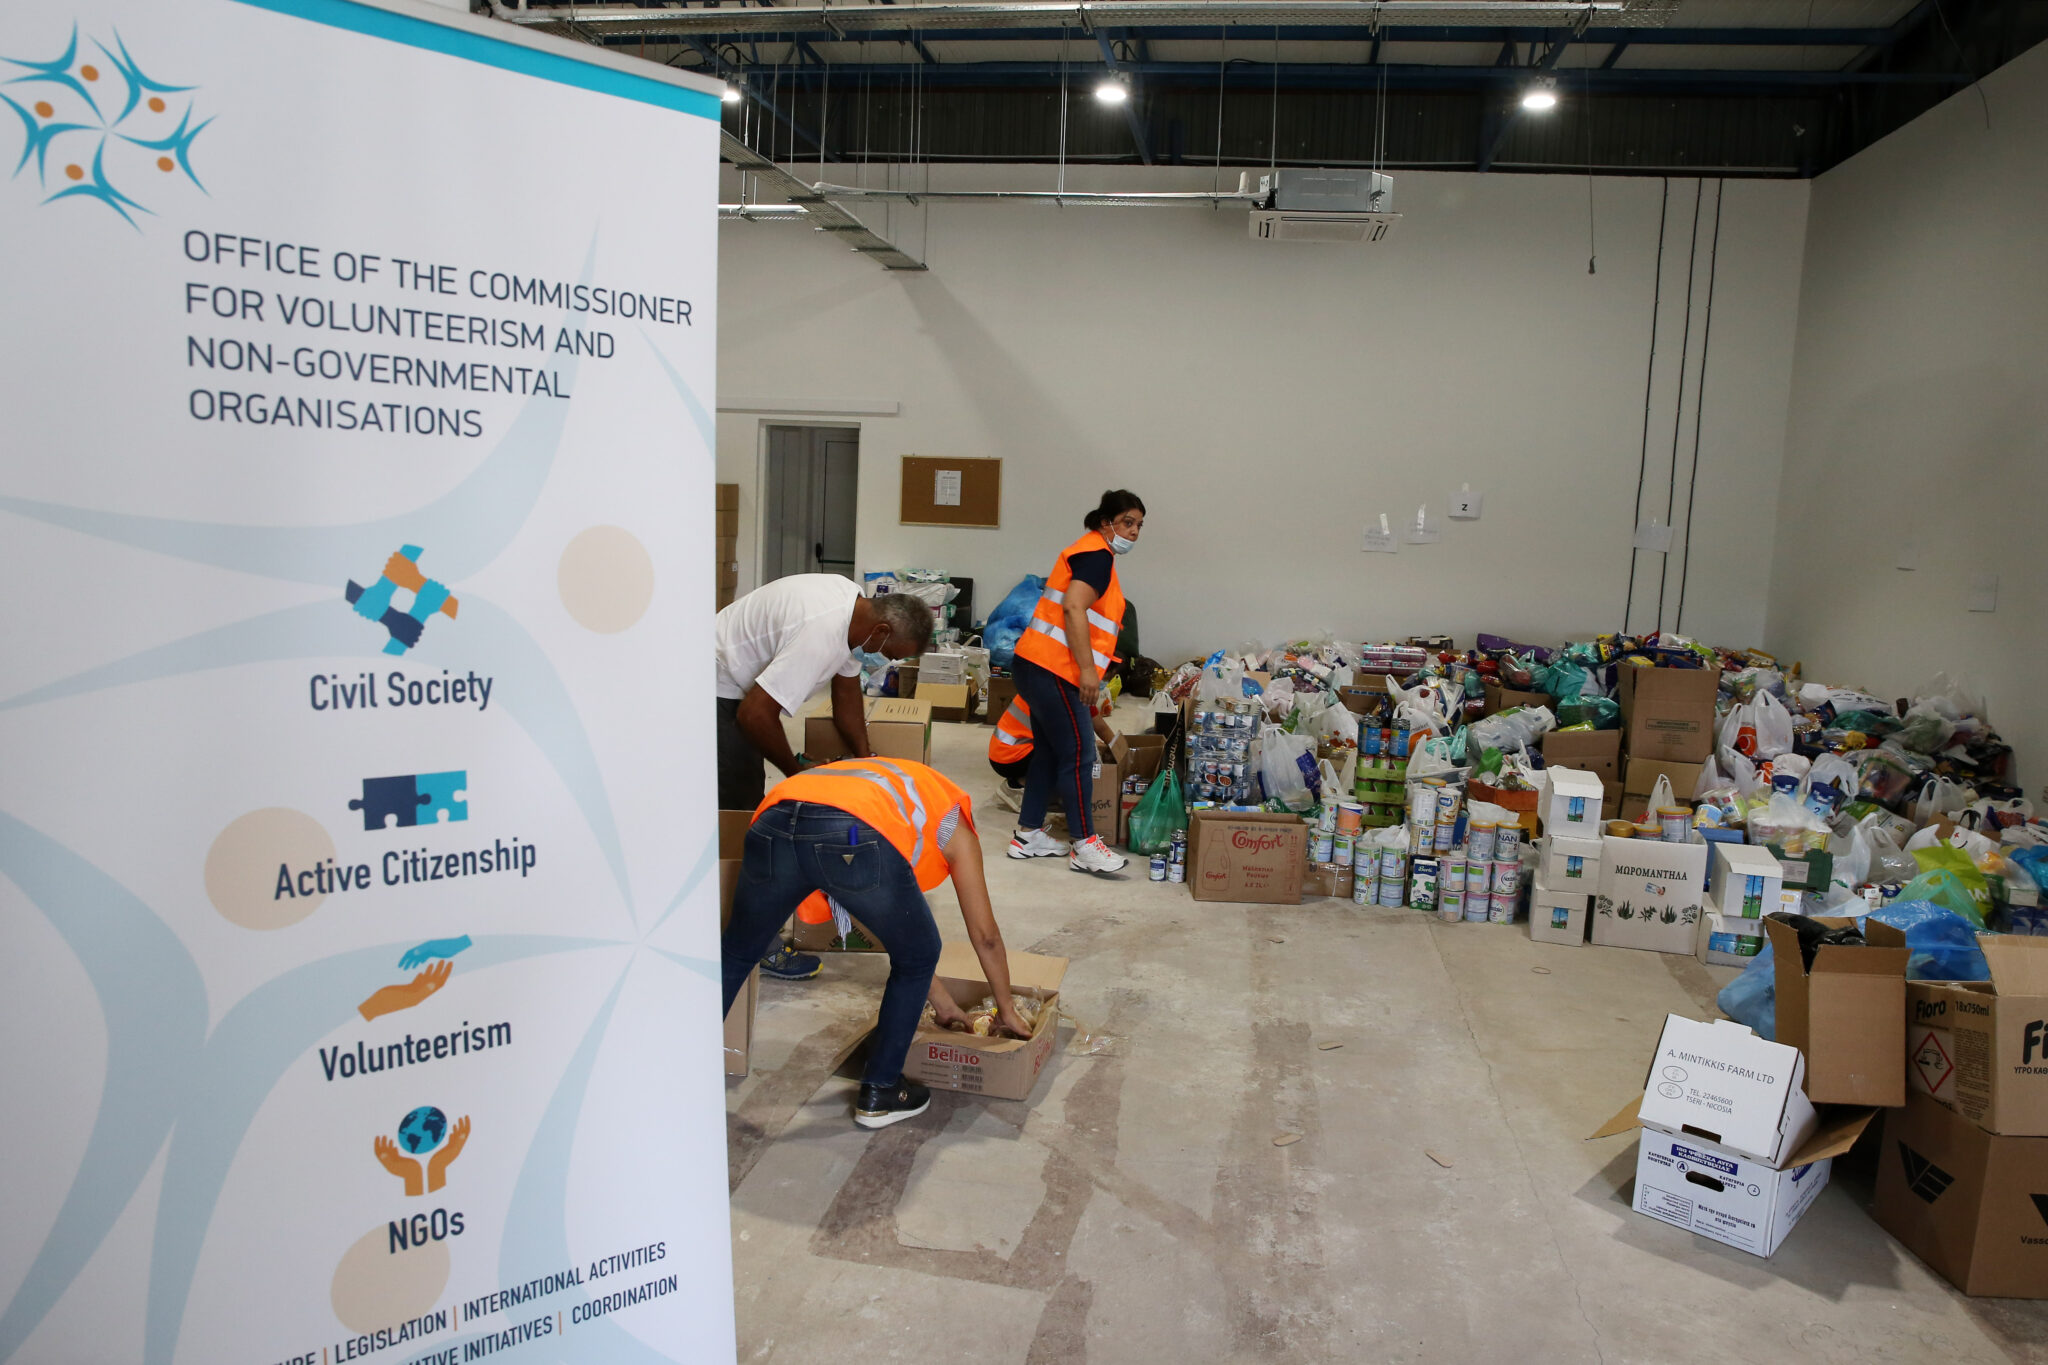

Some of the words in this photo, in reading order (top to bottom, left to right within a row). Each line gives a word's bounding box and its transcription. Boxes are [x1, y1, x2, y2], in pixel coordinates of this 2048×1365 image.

[184, 230, 321, 278] OFFICE
[334, 252, 381, 283] OF
[391, 259, 457, 295] THE
[470, 270, 692, 326] COMMISSIONER
[186, 282, 264, 322] FOR
[276, 294, 544, 351] VOLUNTEERISM
[555, 327, 614, 359] AND
[188, 336, 570, 399] NON-GOVERNMENTAL
[190, 389, 482, 438] ORGANISATIONS
[310, 673, 378, 711] Civil
[387, 671, 493, 711] Society
[1231, 830, 1284, 855] Comfort
[1497, 834, 1518, 843] NAN
[274, 861, 371, 901] Active
[382, 838, 536, 886] Citizenship
[1615, 864, 1688, 881] ΜΩΡΟΜΑΝΤΗΛΑ
[1916, 999, 1946, 1020] Fioro
[1955, 1001, 1990, 1017] 18x750ml
[319, 1022, 512, 1082] Volunteerism
[928, 1045, 980, 1066] Belino
[1667, 1049, 1677, 1059] A.
[1678, 1051, 1725, 1071] MINTIKKIS
[1727, 1065, 1754, 1080] FARM
[1756, 1073, 1774, 1085] LTD
[2014, 1066, 2032, 1074] ΥΓΡΟ
[1686, 1096, 1702, 1106] TSERI
[1706, 1102, 1732, 1115] NICOSIA
[1689, 1088, 1701, 1098] TEL.
[1702, 1091, 1733, 1107] 22465600
[388, 1208, 465, 1255] NGOs
[335, 1309, 447, 1365] LEGISLATION
[463, 1267, 585, 1322] INTERNATIONAL
[589, 1240, 667, 1281] ACTIVITIES
[464, 1315, 553, 1363] INITIATIVES
[572, 1274, 677, 1325] COORDINATION
